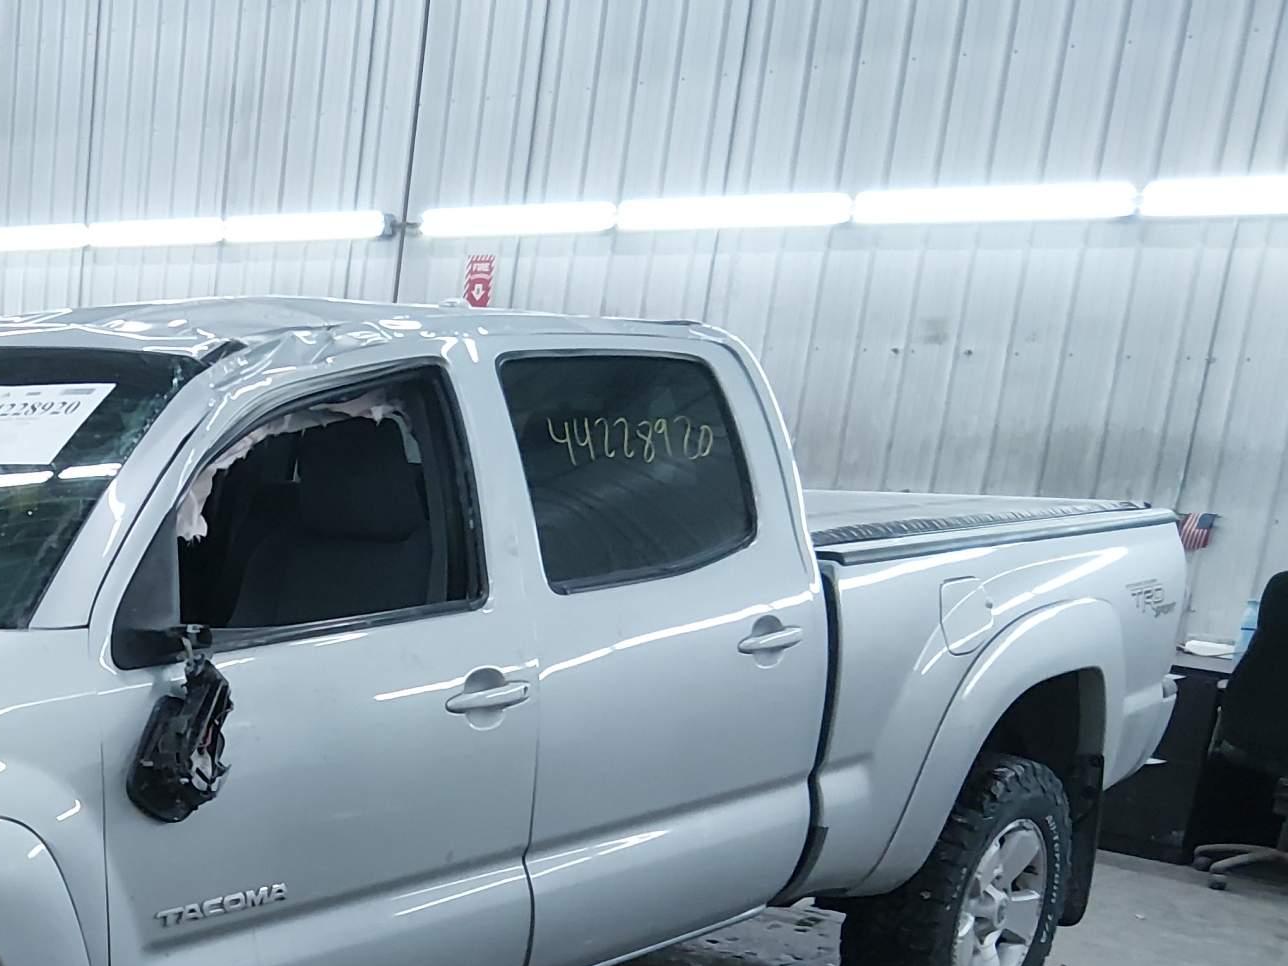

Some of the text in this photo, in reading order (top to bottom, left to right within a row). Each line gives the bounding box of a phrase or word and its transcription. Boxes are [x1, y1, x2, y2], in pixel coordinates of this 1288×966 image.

[546, 415, 713, 467] 44228920
[1130, 585, 1165, 614] TRD
[154, 882, 288, 927] TACOMA
